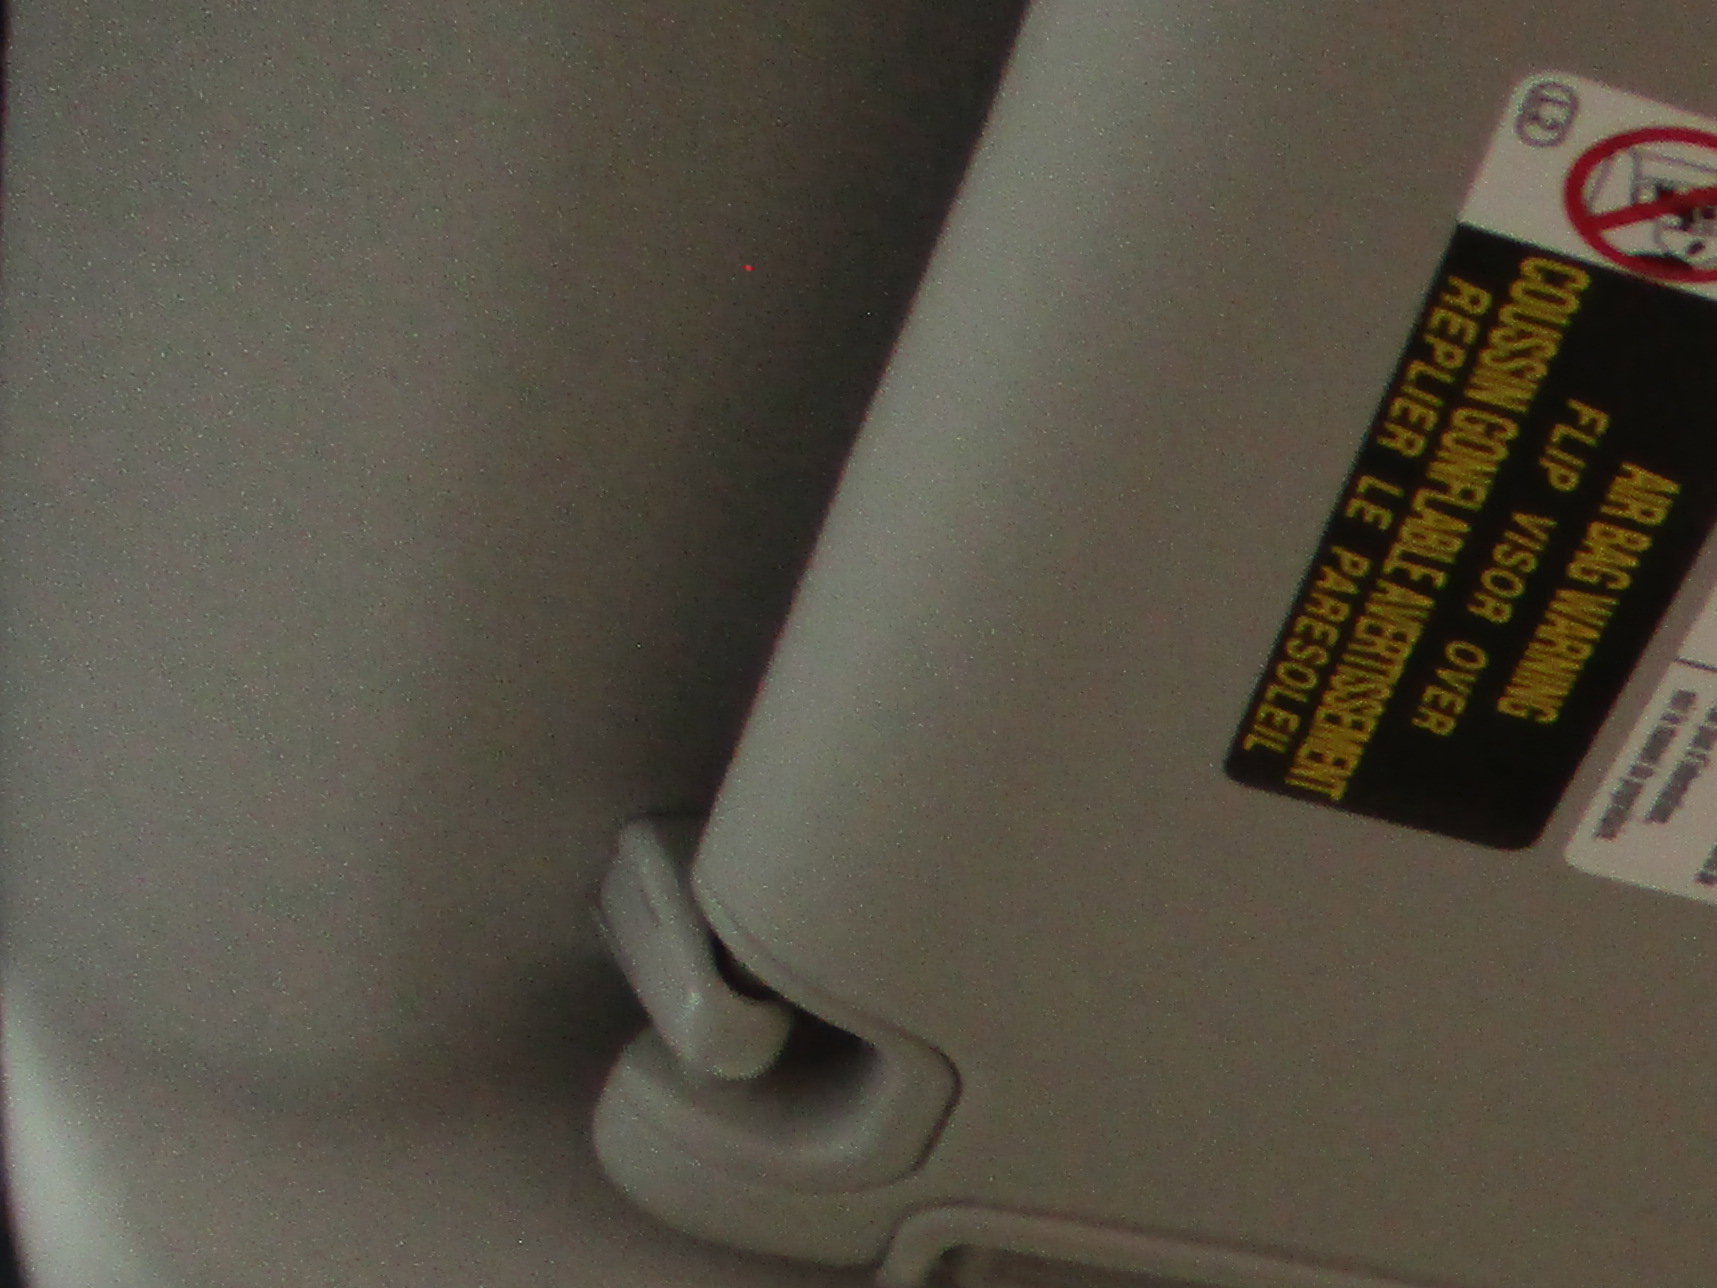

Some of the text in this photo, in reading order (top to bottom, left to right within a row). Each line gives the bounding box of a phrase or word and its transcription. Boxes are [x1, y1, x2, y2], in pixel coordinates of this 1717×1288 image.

[1242, 276, 1491, 752] REPLIER LE PARESOLEIL
[1286, 256, 1590, 801] COUSSIN GONFLABLE AVERTISSEMENT
[1411, 399, 1609, 735] FLIP VISOR OVER
[1567, 521, 1651, 589] BAG
[1600, 462, 1679, 525] AIR
[1496, 588, 1617, 723] WARNING
